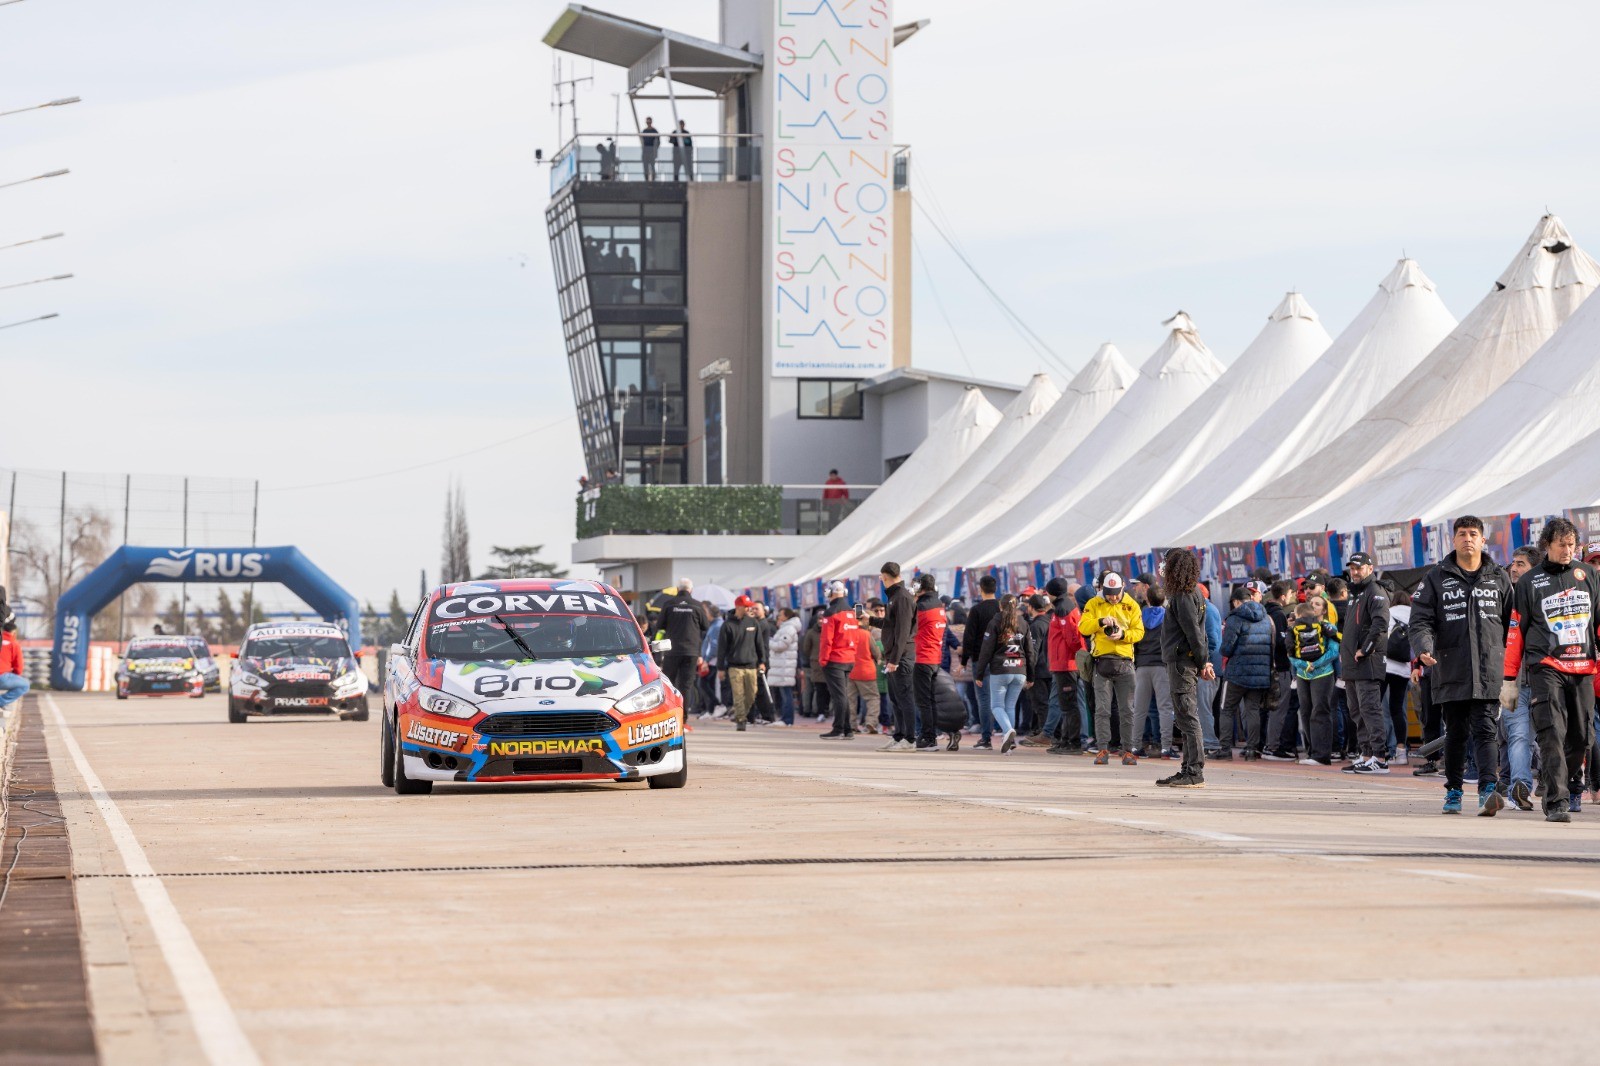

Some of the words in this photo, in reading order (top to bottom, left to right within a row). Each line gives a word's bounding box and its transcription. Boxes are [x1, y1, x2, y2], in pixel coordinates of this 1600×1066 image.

[777, 36, 888, 67] SAN
[776, 148, 888, 179] SAN
[775, 251, 888, 282] SAN
[195, 553, 263, 578] RUS
[435, 594, 621, 618] CORVEN
[61, 615, 79, 653] RUS
[256, 627, 336, 637] AUTOSTOP
[274, 697, 329, 706] PRADECON
[432, 699, 451, 713] 8
